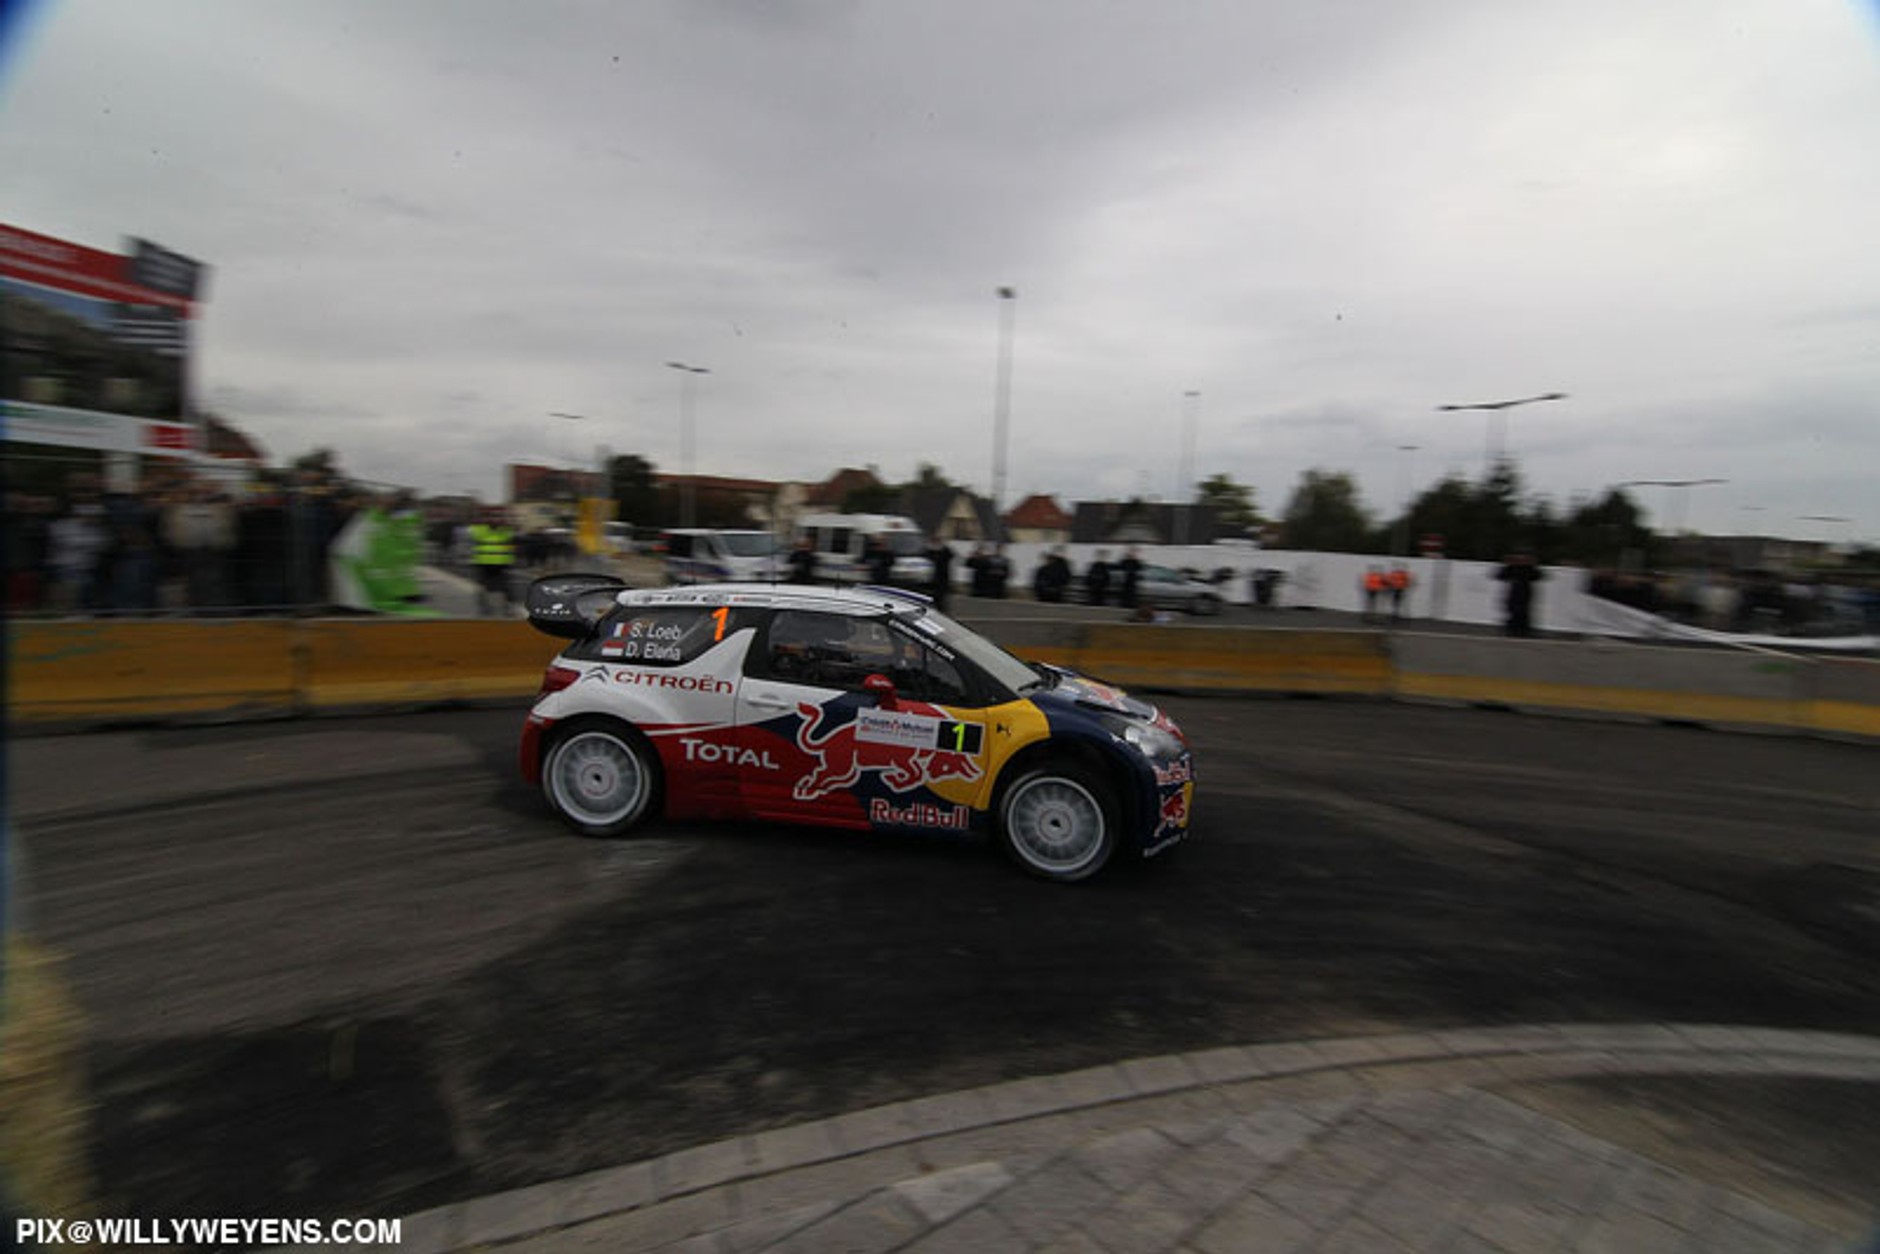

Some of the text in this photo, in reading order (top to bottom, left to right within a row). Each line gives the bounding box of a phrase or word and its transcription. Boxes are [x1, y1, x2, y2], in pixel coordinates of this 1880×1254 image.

[648, 622, 682, 640] Loeb
[711, 607, 731, 642] 1
[624, 641, 641, 658] D.
[951, 723, 966, 752] 1
[679, 738, 781, 770] TOTAL
